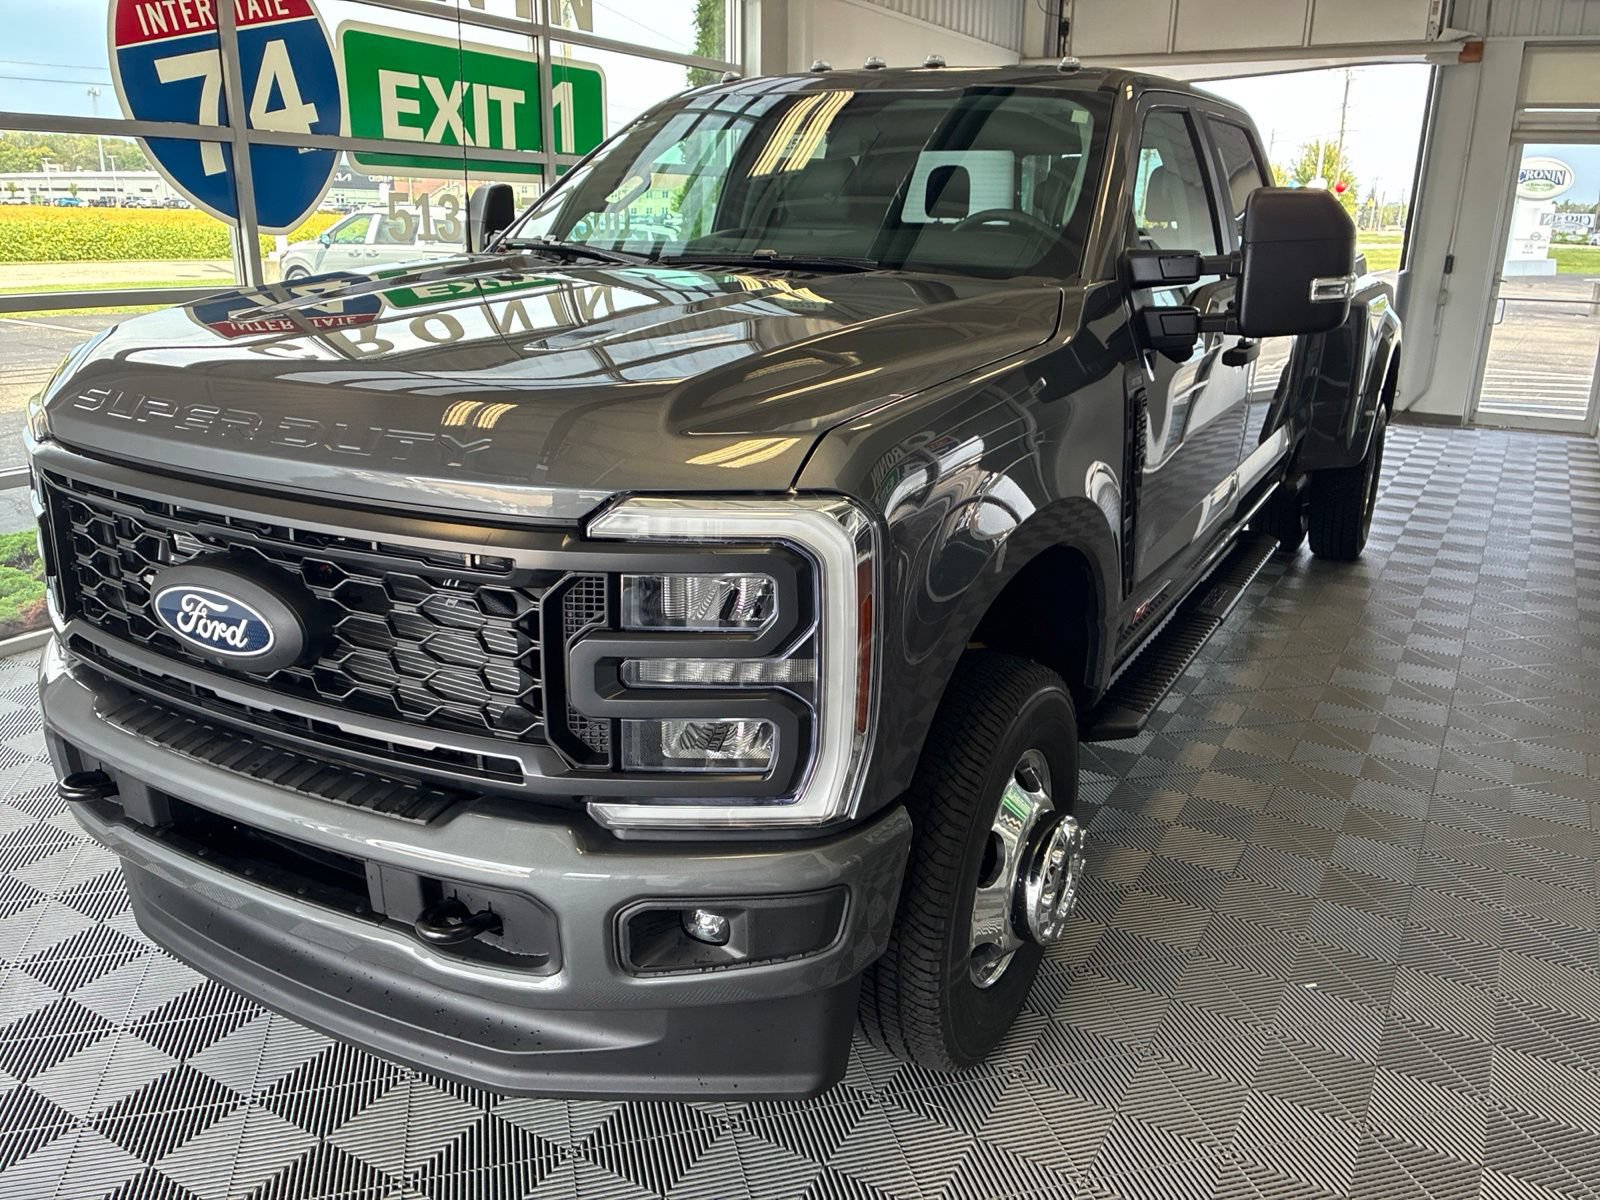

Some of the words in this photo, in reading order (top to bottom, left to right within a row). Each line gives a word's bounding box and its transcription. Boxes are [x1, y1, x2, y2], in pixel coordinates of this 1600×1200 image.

[136, 0, 290, 37] INTERTATE
[154, 39, 320, 176] 74
[378, 69, 526, 152] EXIT
[551, 81, 576, 153] 1
[388, 192, 462, 243] 513
[73, 387, 264, 441] SUPER
[269, 416, 493, 468] DUTY
[178, 593, 249, 650] Ford
